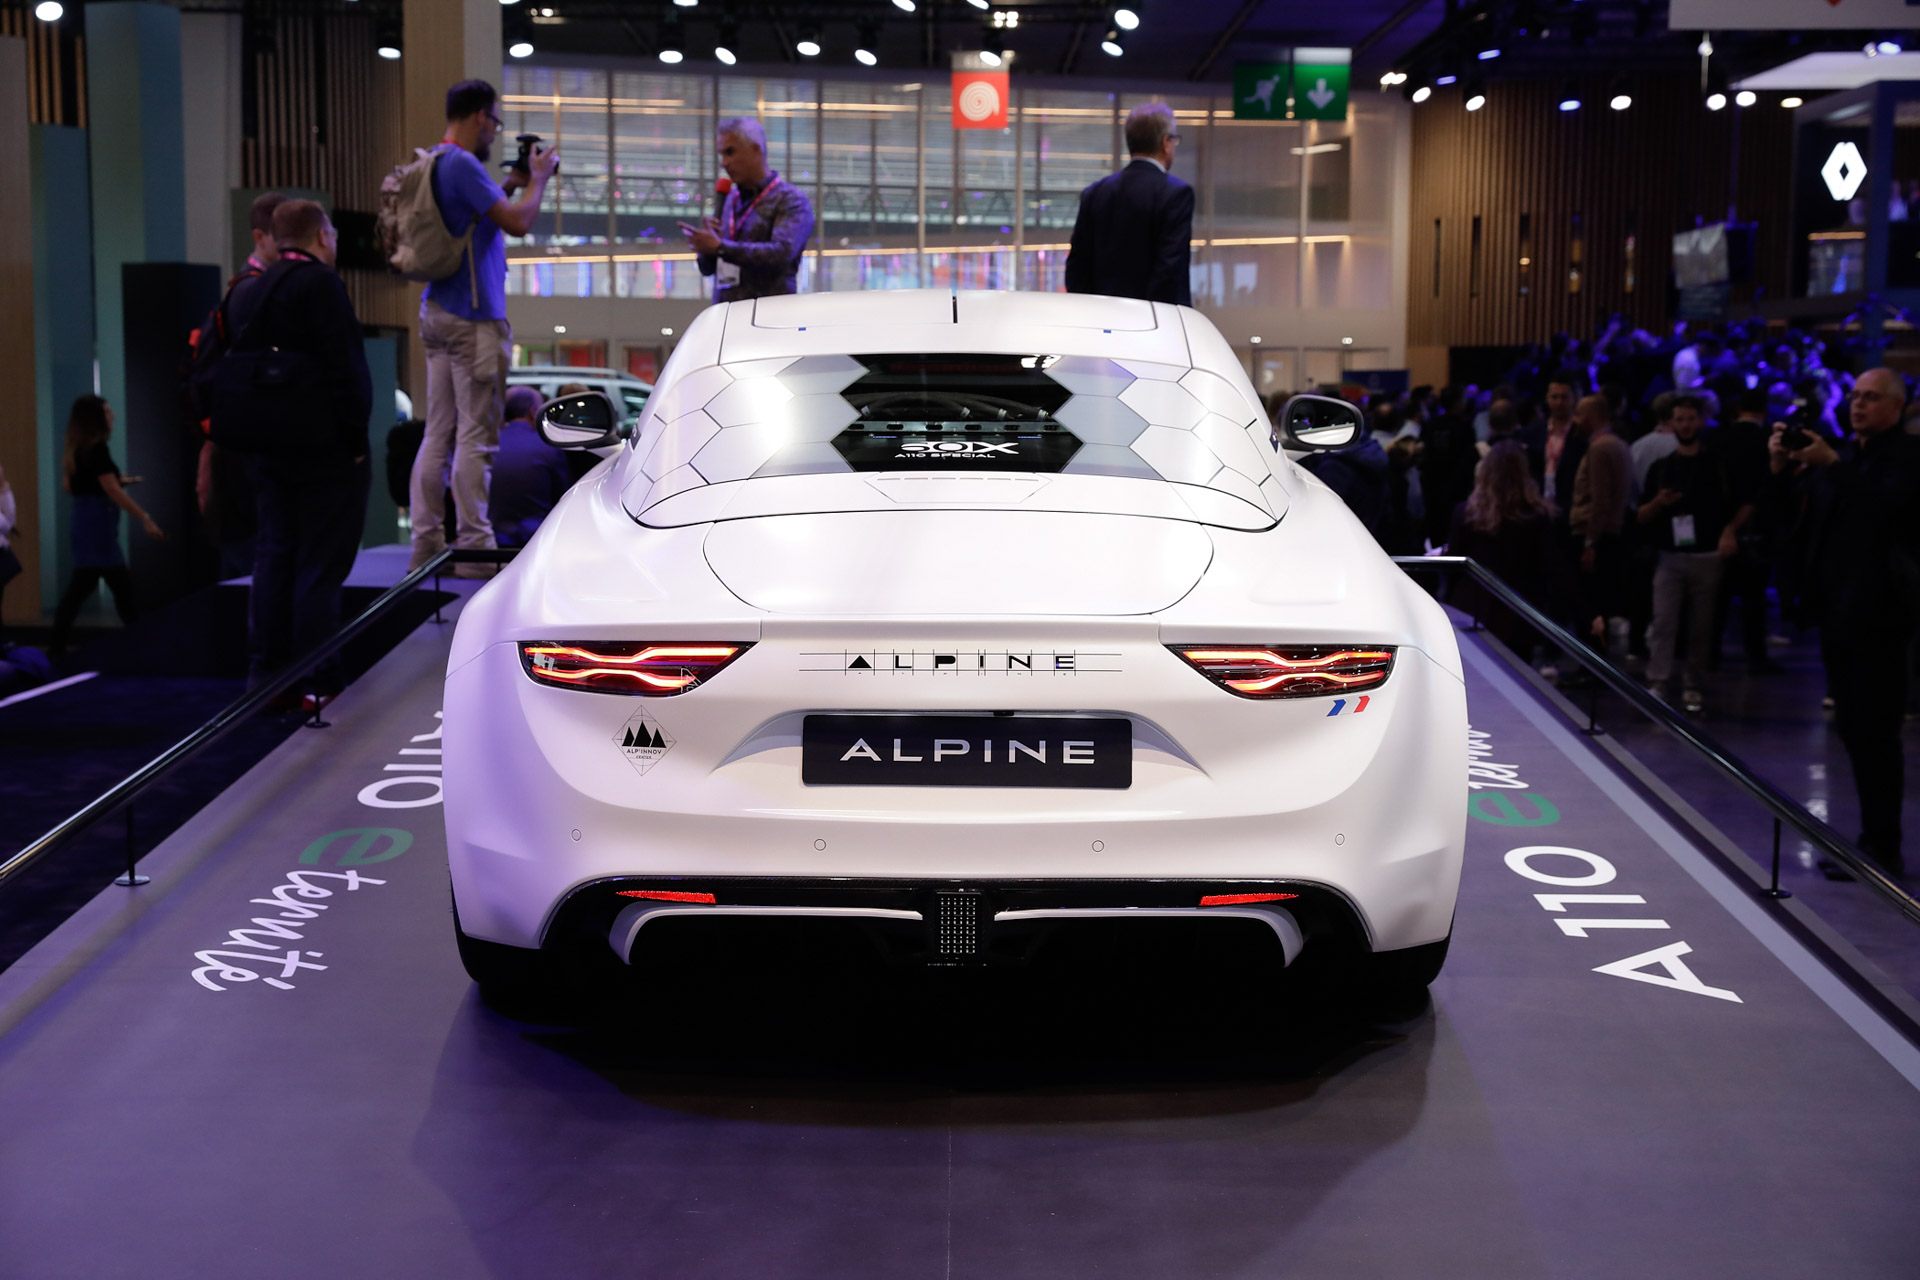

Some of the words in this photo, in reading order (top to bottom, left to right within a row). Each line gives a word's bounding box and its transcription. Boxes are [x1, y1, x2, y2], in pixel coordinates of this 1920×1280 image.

[847, 655, 1074, 670] ALPINE
[840, 737, 1095, 765] ALPINE
[1503, 845, 1744, 1004] A110
